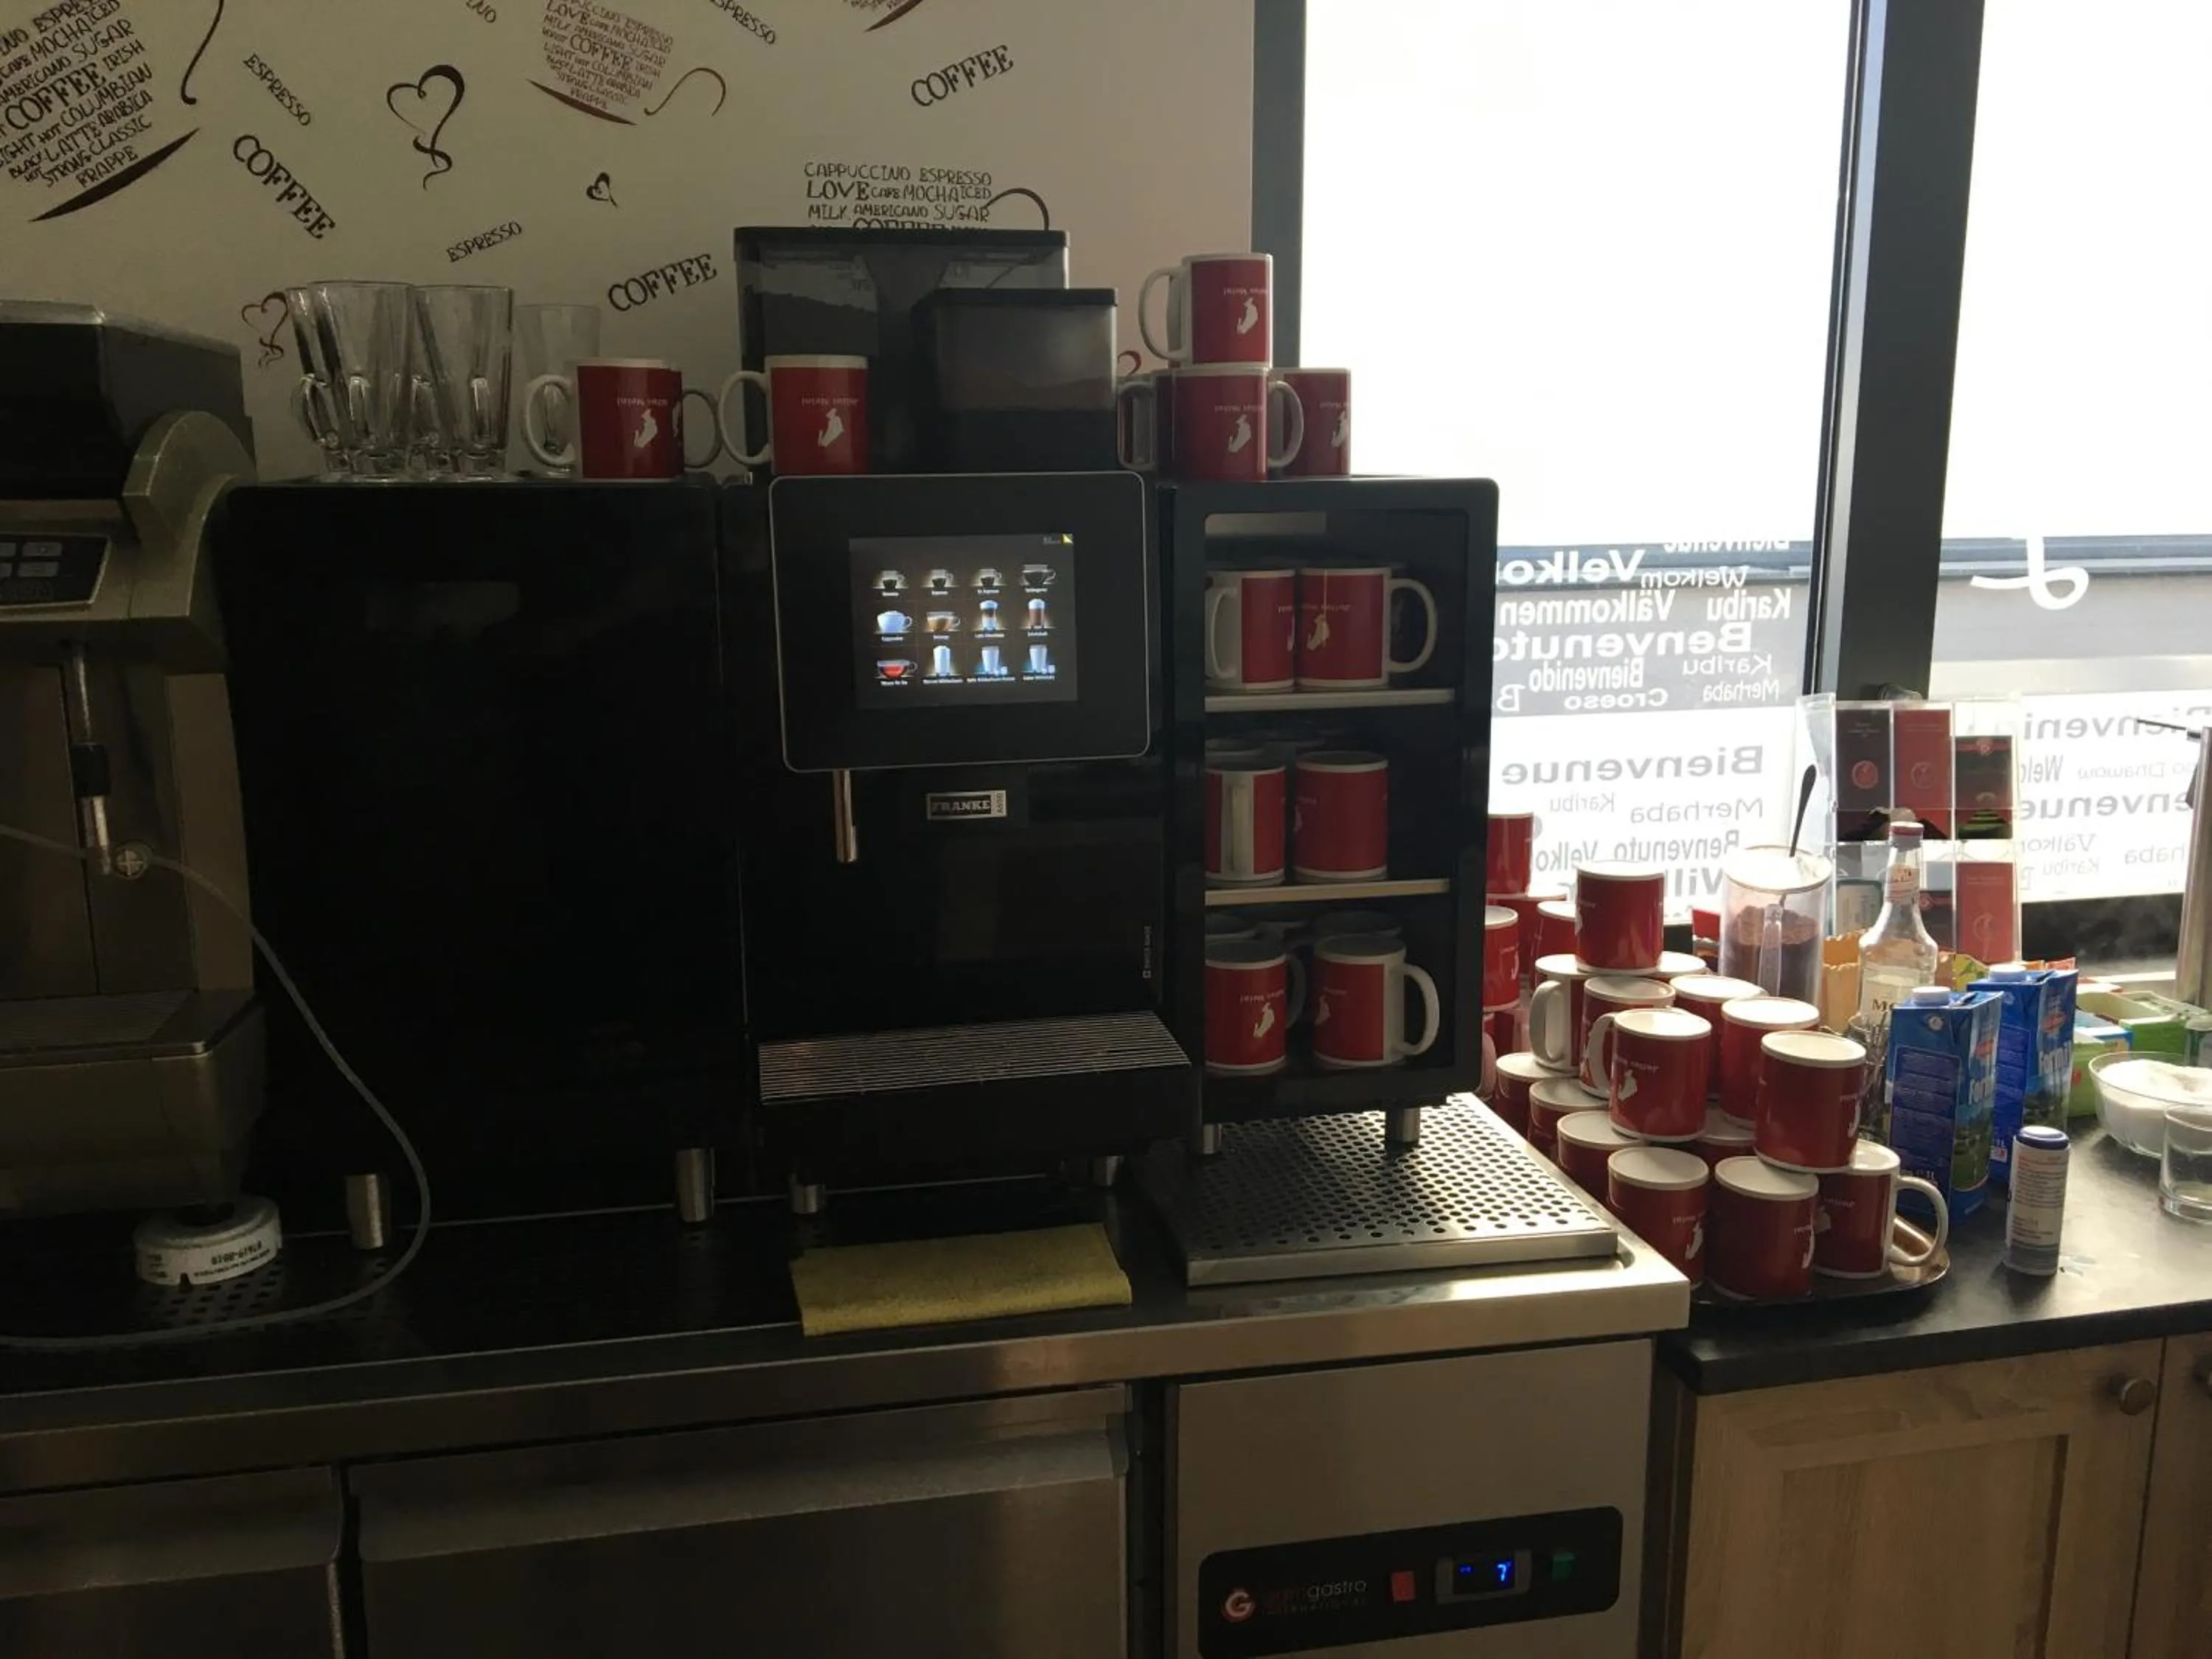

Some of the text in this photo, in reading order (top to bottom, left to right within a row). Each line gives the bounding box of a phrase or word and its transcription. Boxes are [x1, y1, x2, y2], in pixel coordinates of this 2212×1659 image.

[29, 18, 93, 62] MOCHA
[72, 19, 134, 63] SUGAR
[5, 38, 145, 131] COFFEE IRISH
[243, 53, 311, 127] ESPRESSO
[911, 44, 1014, 107] COFFEE
[37, 122, 62, 144] HOT
[60, 60, 153, 128] COLUMBIAN
[44, 120, 102, 162] LATTE
[88, 114, 153, 156] CLASSIC
[74, 145, 139, 188] FRAPPE
[232, 134, 336, 240] COFFEE
[804, 162, 992, 185] CAPPUCCINO ESPRESSO
[806, 180, 992, 204] LOVE CAFE MOCHA ICED
[808, 204, 990, 223] MILK AMERICANO SUGAR
[447, 221, 522, 263] ESPRESSO
[608, 253, 718, 313] COFFEE
[931, 800, 991, 813] FRANKE
[1497, 1563, 1507, 1582] 7
